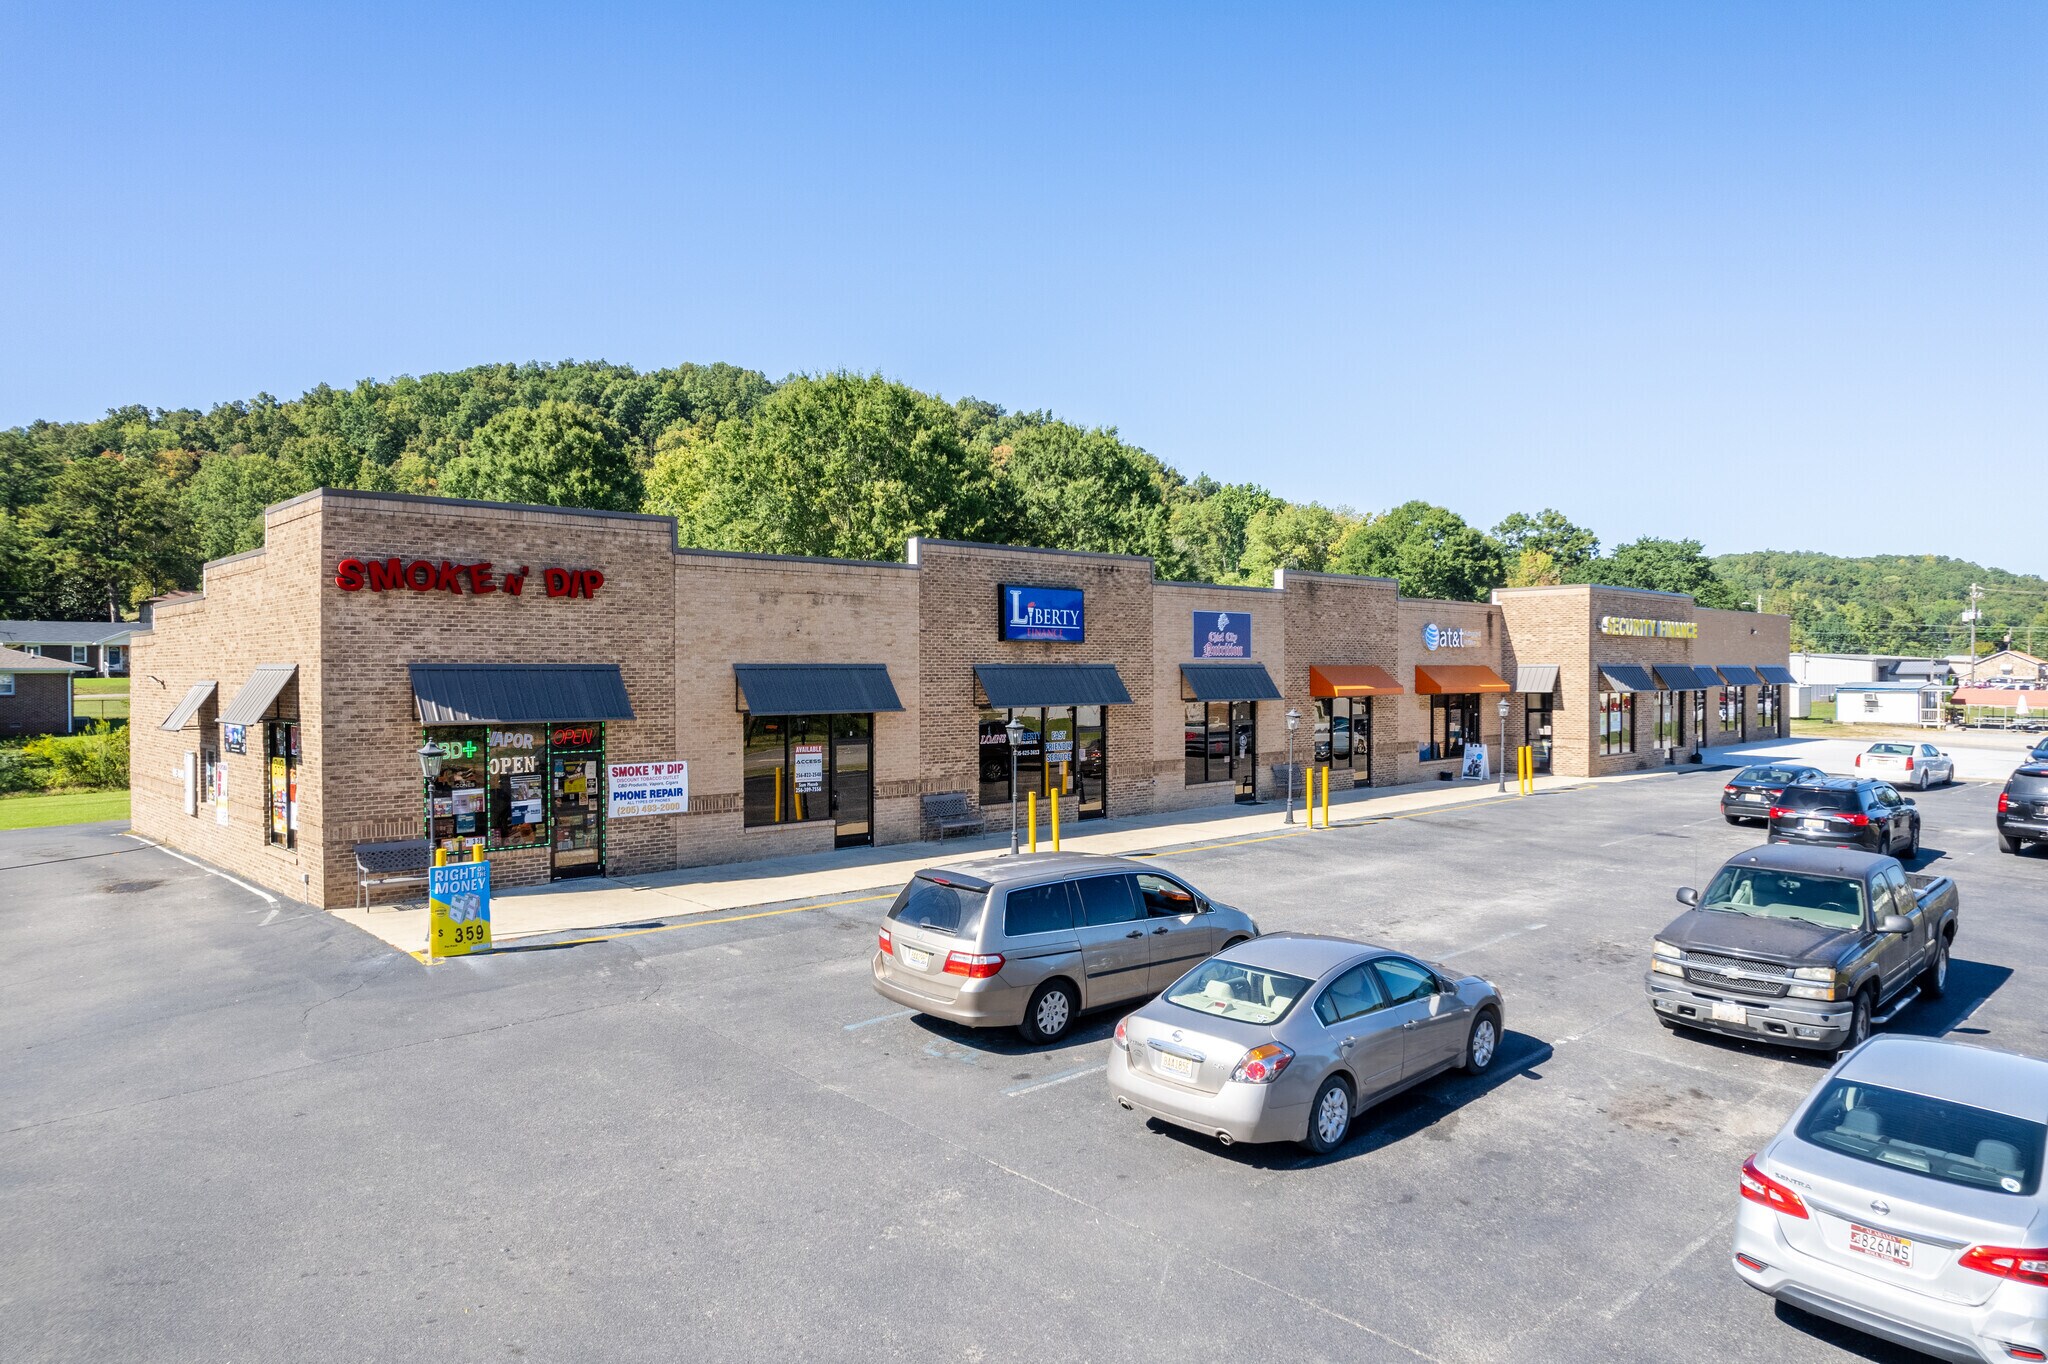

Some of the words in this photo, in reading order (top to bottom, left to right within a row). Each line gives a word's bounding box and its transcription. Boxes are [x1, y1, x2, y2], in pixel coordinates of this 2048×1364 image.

[335, 557, 497, 595] SMOKE
[544, 567, 604, 599] DIP
[1027, 628, 1063, 638] FINANCE
[1601, 616, 1656, 637] SECURITY
[1659, 619, 1698, 639] FINANCE
[1439, 627, 1464, 648] at&t
[553, 729, 593, 745] OPEN
[1051, 730, 1067, 740] FAST
[439, 740, 477, 760] BD+
[1045, 741, 1073, 752] FRIENDLY
[1046, 752, 1072, 762] SERVICE
[489, 756, 536, 775] OPEN
[612, 765, 649, 778] SMOKE
[667, 763, 684, 775] DIP
[613, 790, 647, 801] PHONE
[649, 787, 683, 799] REPAIR
[617, 805, 639, 816] (205)
[434, 866, 477, 882] RIGHT
[434, 877, 486, 895] MONEY
[438, 929, 444, 938] $
[1861, 1233, 1909, 1260] 826AWS
